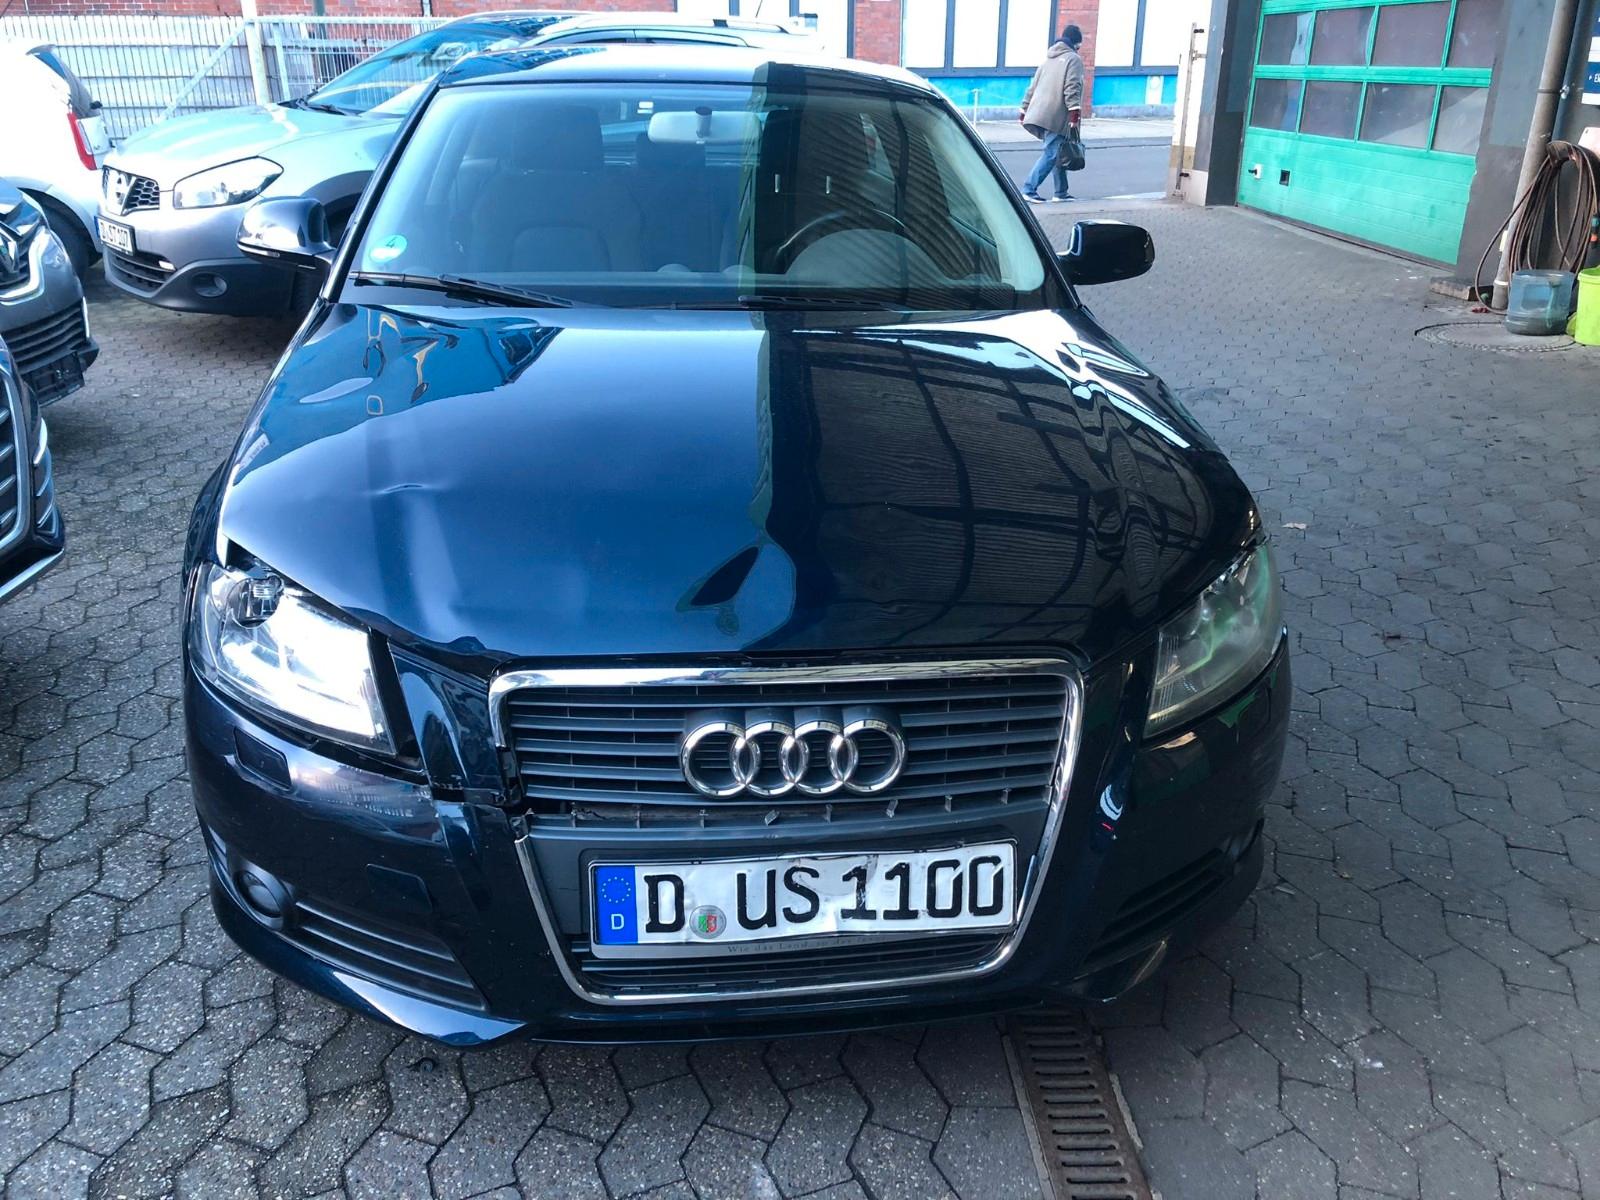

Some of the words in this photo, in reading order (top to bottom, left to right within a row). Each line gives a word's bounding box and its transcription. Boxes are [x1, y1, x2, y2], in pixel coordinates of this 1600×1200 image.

[643, 874, 685, 933] D
[736, 868, 820, 930] US
[840, 855, 1004, 920] 1100
[611, 914, 625, 930] D
